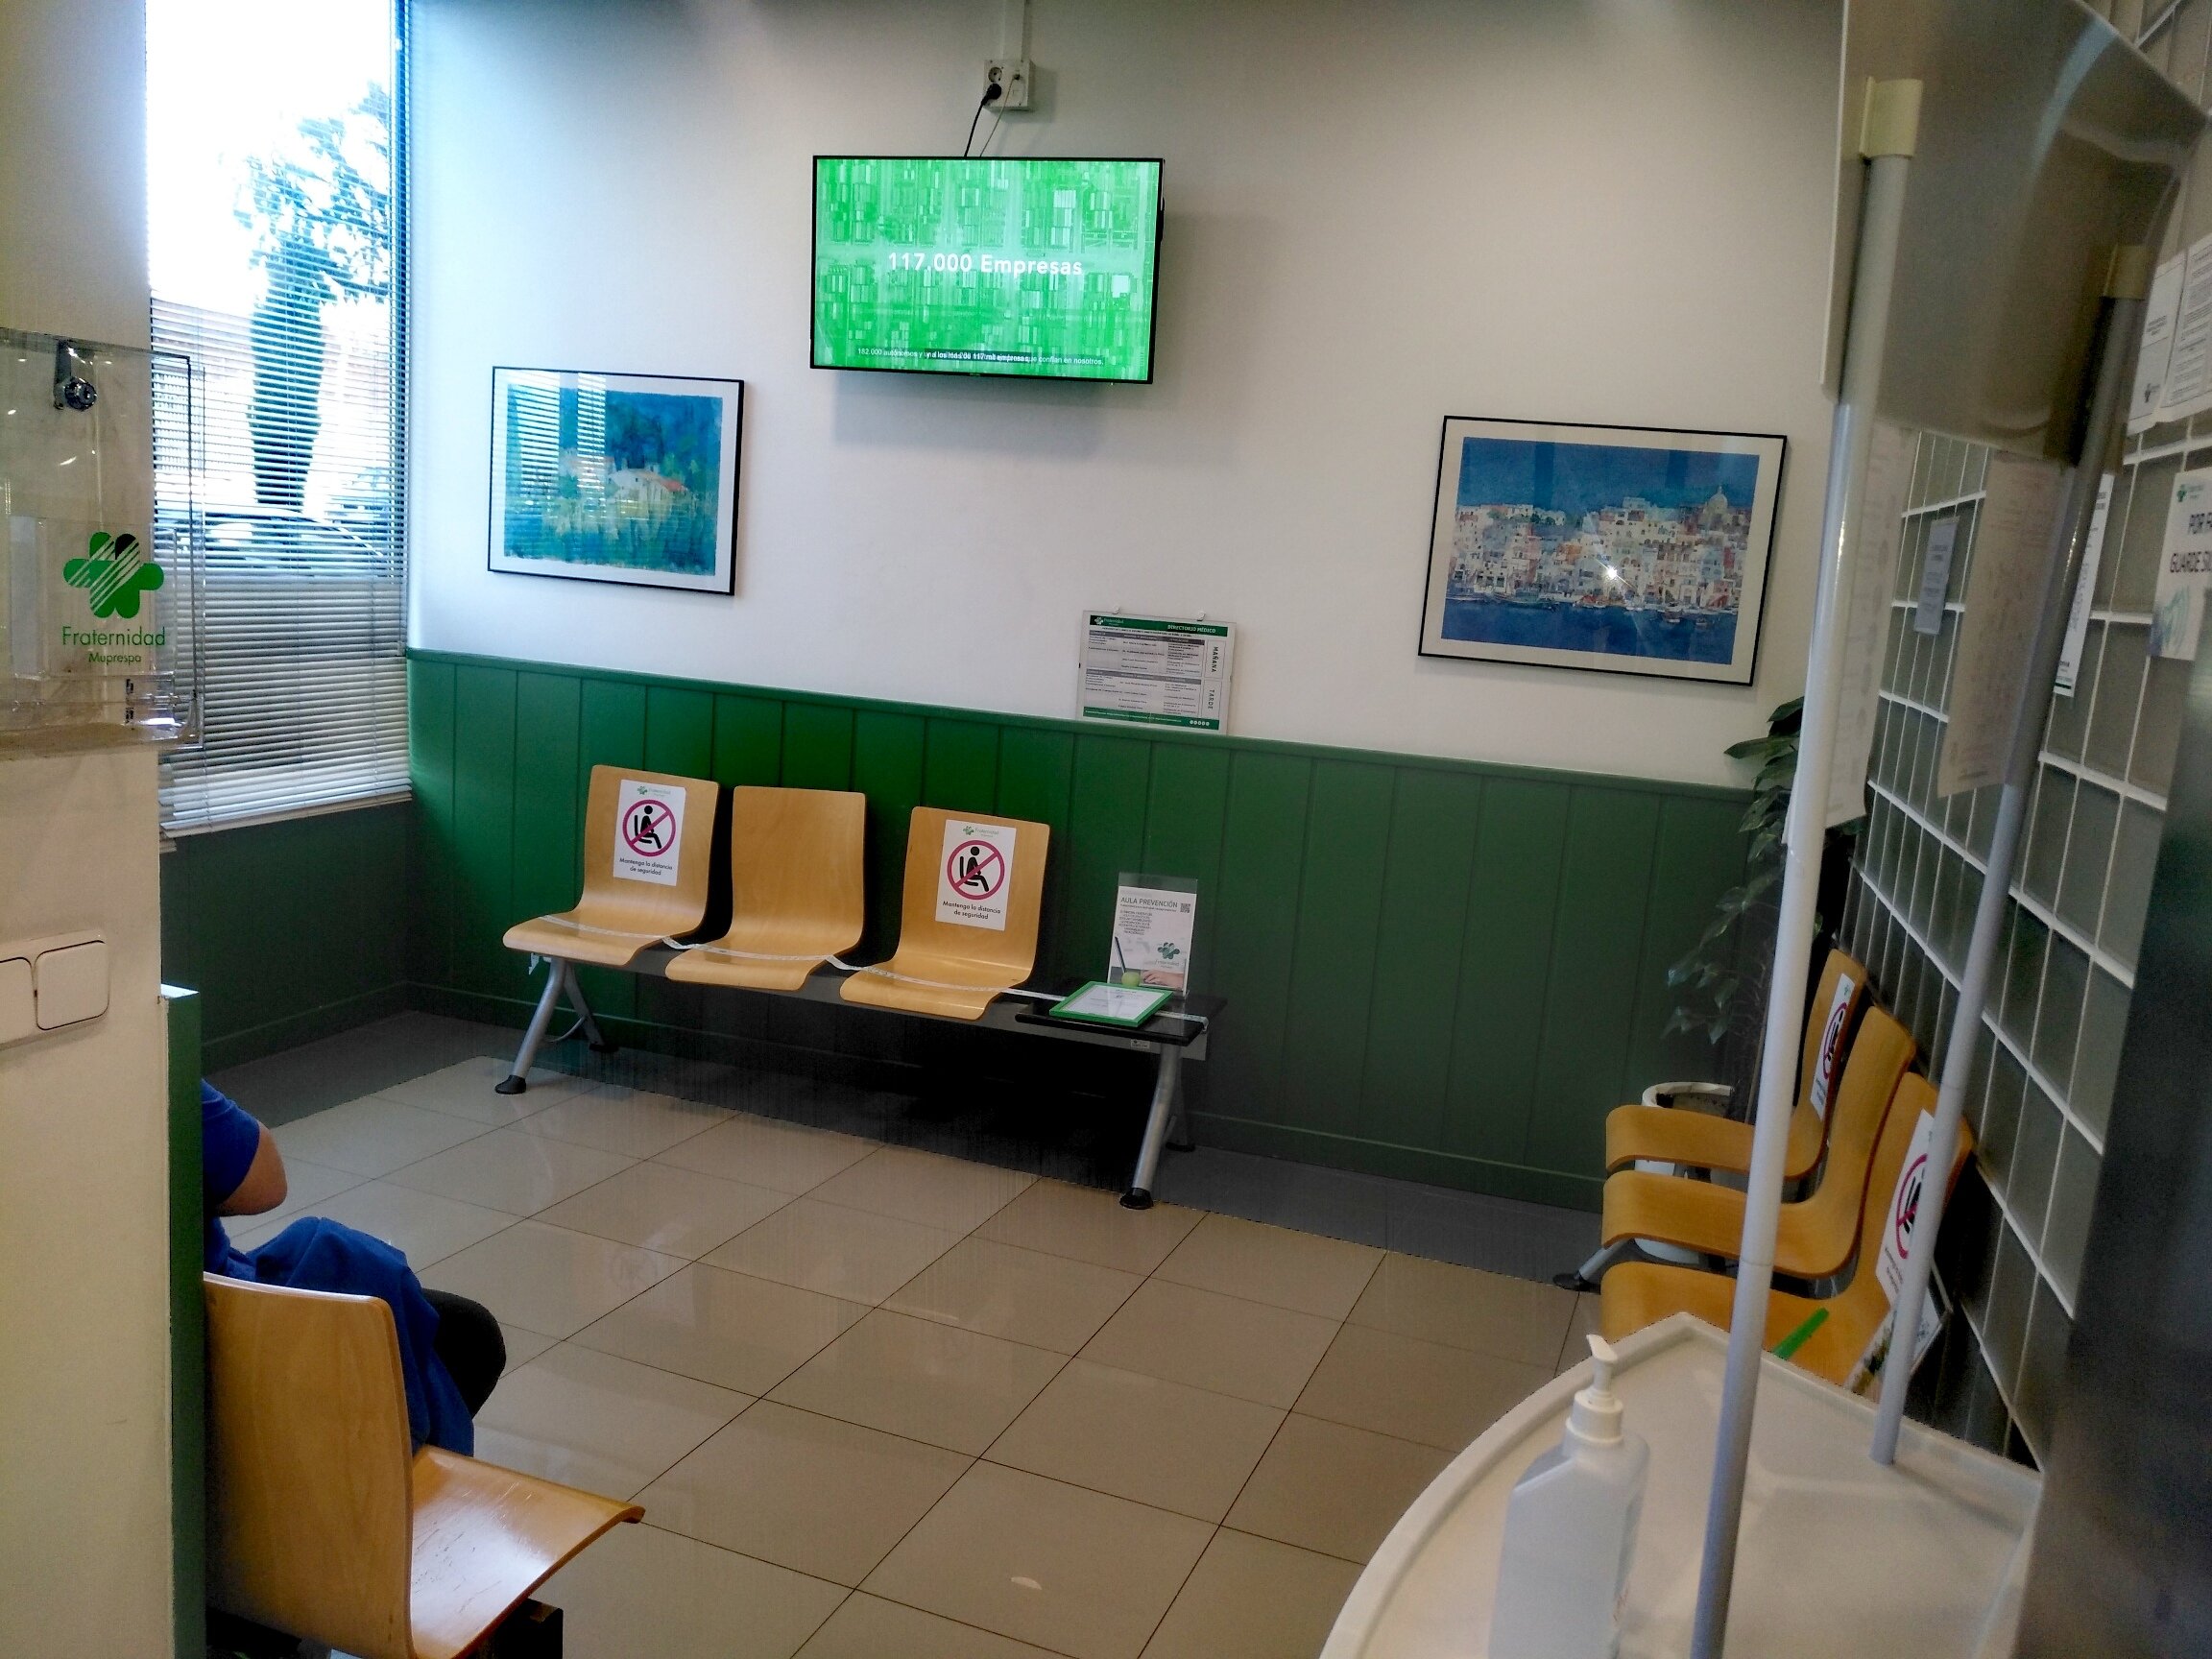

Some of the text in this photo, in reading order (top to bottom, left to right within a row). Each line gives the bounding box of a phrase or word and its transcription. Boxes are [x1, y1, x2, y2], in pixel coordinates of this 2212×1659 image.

[888, 252, 1083, 278] 117.000 Empresas
[62, 626, 166, 646] Fraternidad
[88, 653, 142, 666] Muprespa
[1211, 646, 1219, 673] MAÑANA
[1207, 689, 1215, 709] TARDE
[619, 857, 645, 866] Mantenga
[942, 901, 970, 910] Mantenga
[977, 905, 1001, 914] distancia
[1139, 898, 1178, 908] PREVENCIÓN
[962, 911, 989, 920] seguridad
